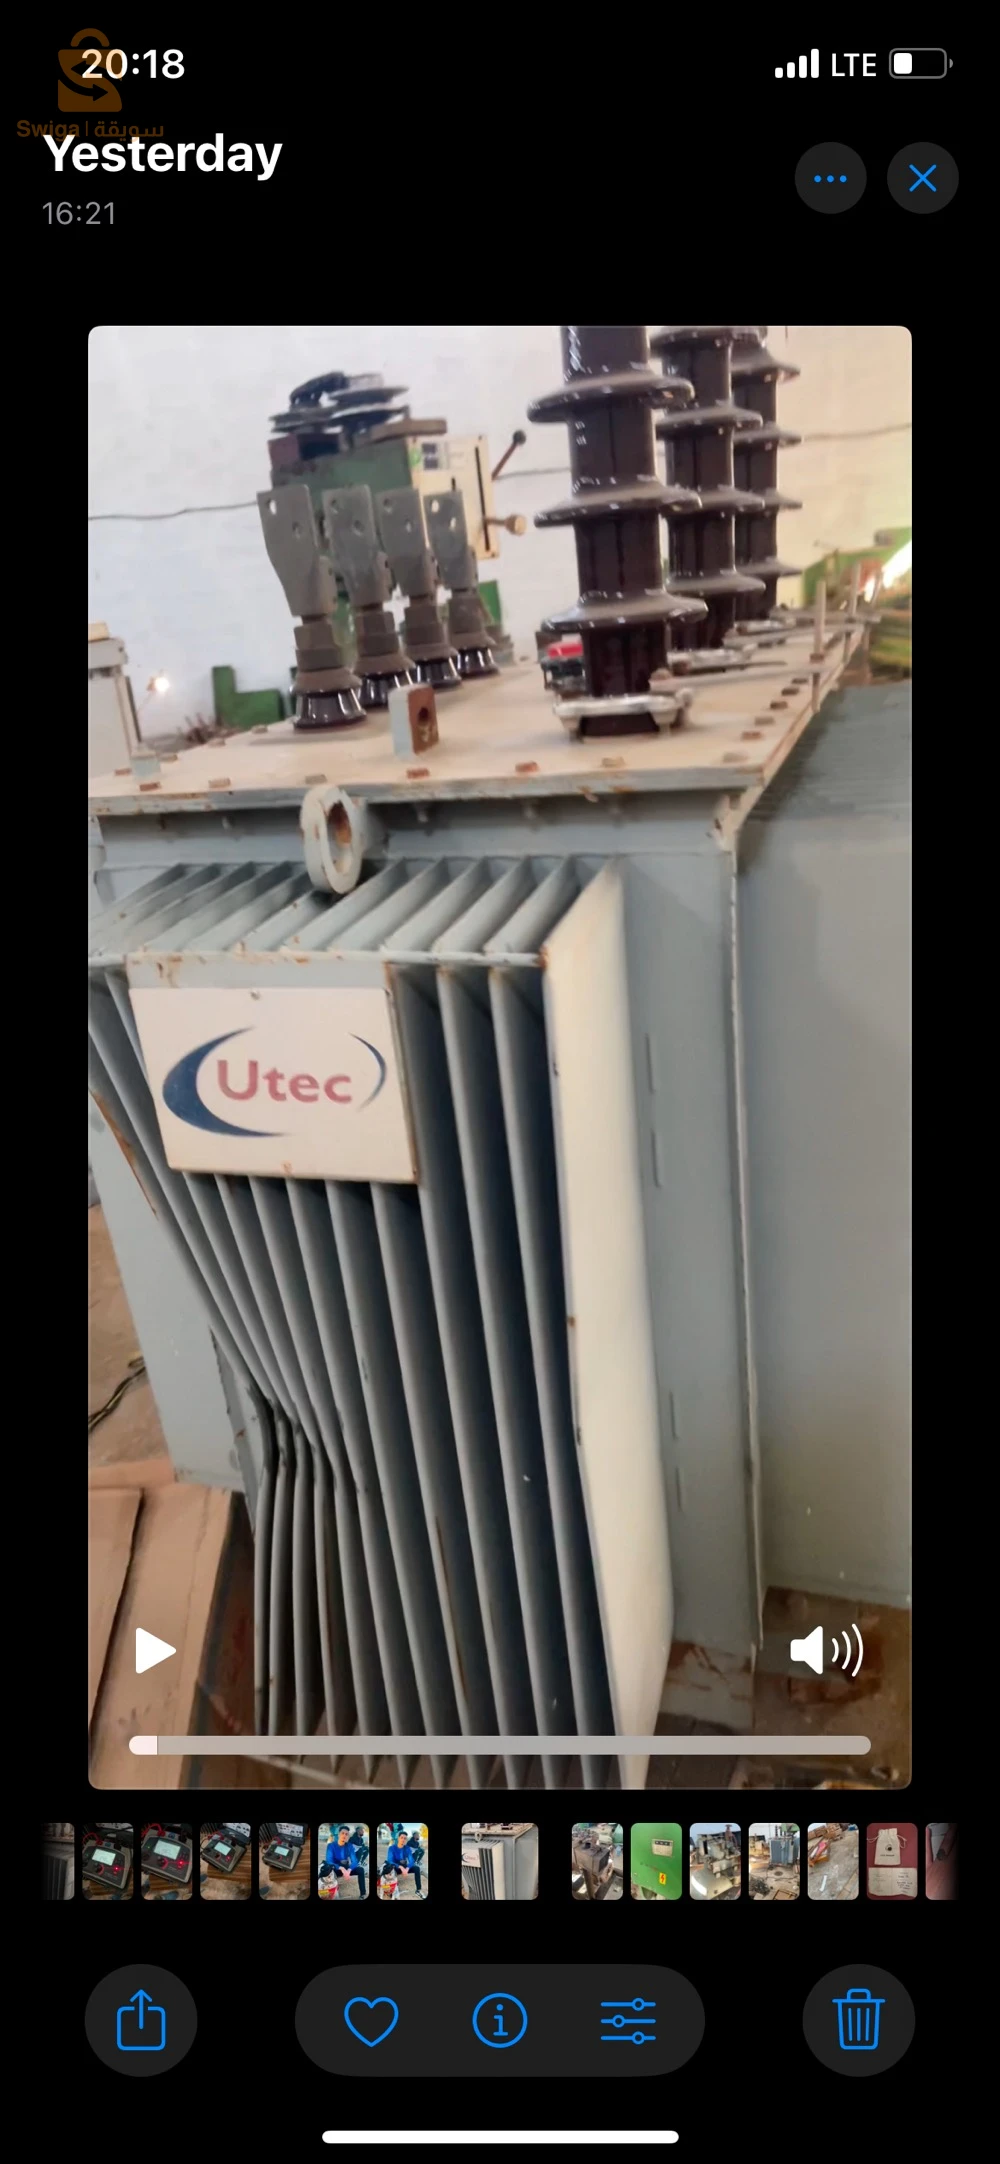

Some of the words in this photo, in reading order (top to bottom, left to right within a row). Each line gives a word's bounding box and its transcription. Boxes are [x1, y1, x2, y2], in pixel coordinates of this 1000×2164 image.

[81, 49, 185, 79] 20:18
[831, 53, 877, 77] LTE
[43, 132, 283, 181] Yesterday
[42, 201, 115, 225] 16:21
[217, 1059, 353, 1104] Utec
